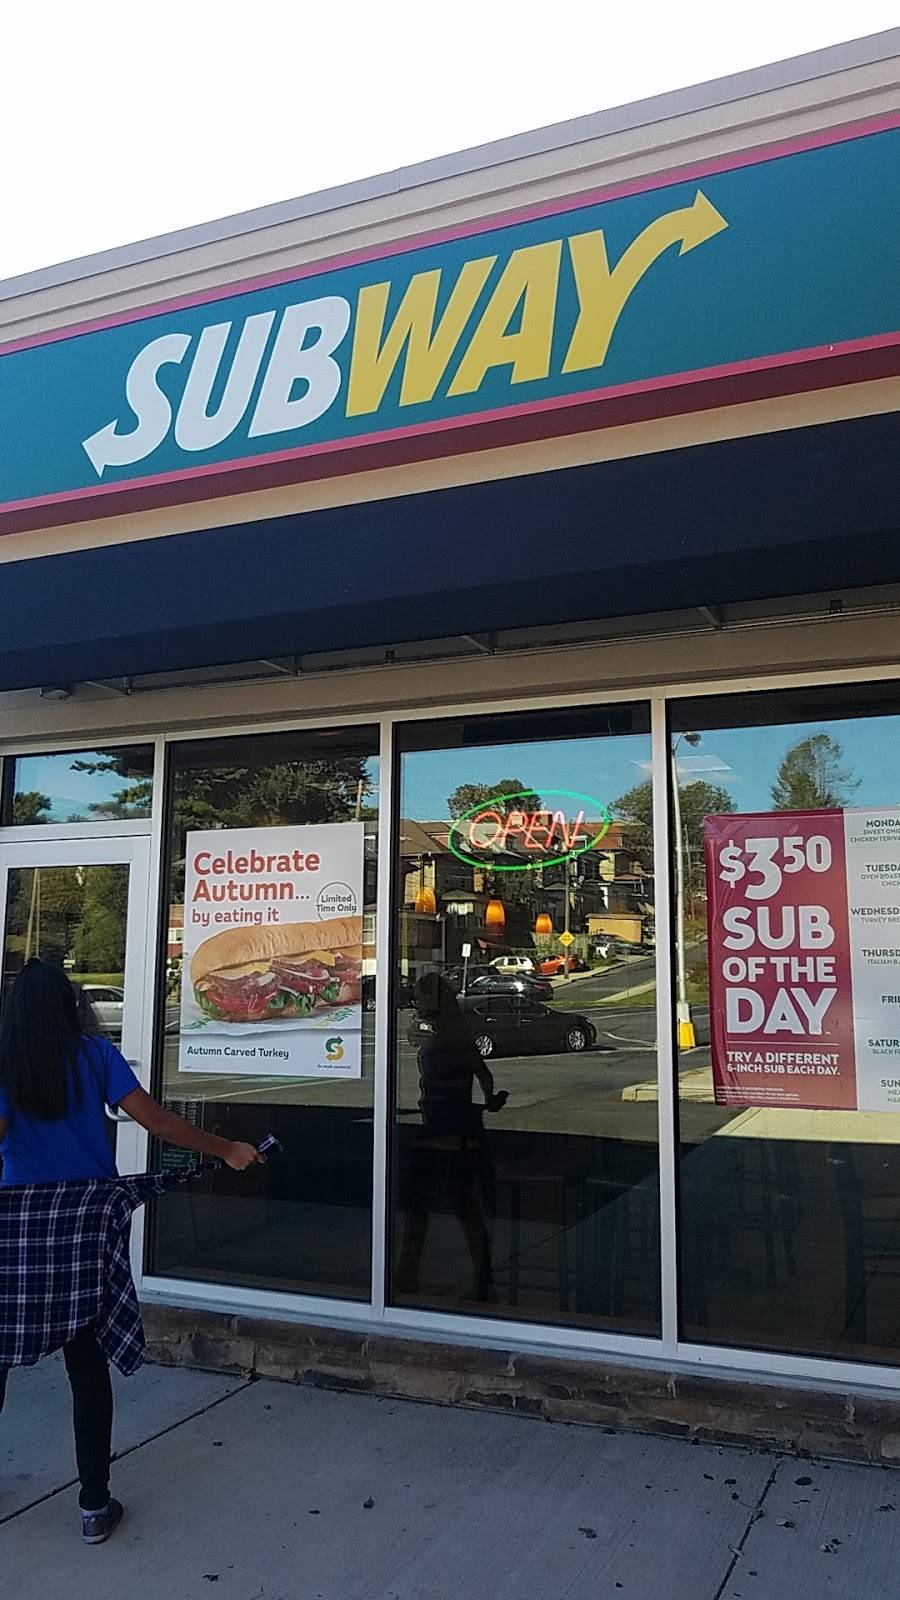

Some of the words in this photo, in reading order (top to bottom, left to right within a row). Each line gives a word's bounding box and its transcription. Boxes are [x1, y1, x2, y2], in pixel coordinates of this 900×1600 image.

[82, 189, 729, 478] SUBWAY
[470, 810, 584, 849] OPEN
[193, 850, 320, 875] Celebrate
[192, 879, 310, 902] Autumn...
[321, 894, 352, 903] Limited
[192, 908, 210, 927] by
[214, 907, 263, 926] eating
[267, 907, 279, 922] it
[316, 904, 336, 912] Time
[337, 903, 357, 914] Only
[722, 905, 835, 950] SUB
[722, 957, 767, 983] OF
[770, 957, 837, 983] THE
[725, 987, 838, 1035] DAY
[187, 1046, 222, 1056] Autumn
[224, 1046, 256, 1057] Carved
[258, 1048, 290, 1060] Turkey
[727, 1051, 752, 1063] TRY
[754, 1053, 764, 1063] A
[766, 1052, 840, 1065] DIFFERENT
[727, 1063, 762, 1073] 6-INCH
[764, 1064, 785, 1074] SUB
[787, 1065, 815, 1075] EACH
[817, 1066, 841, 1076] DAY.
